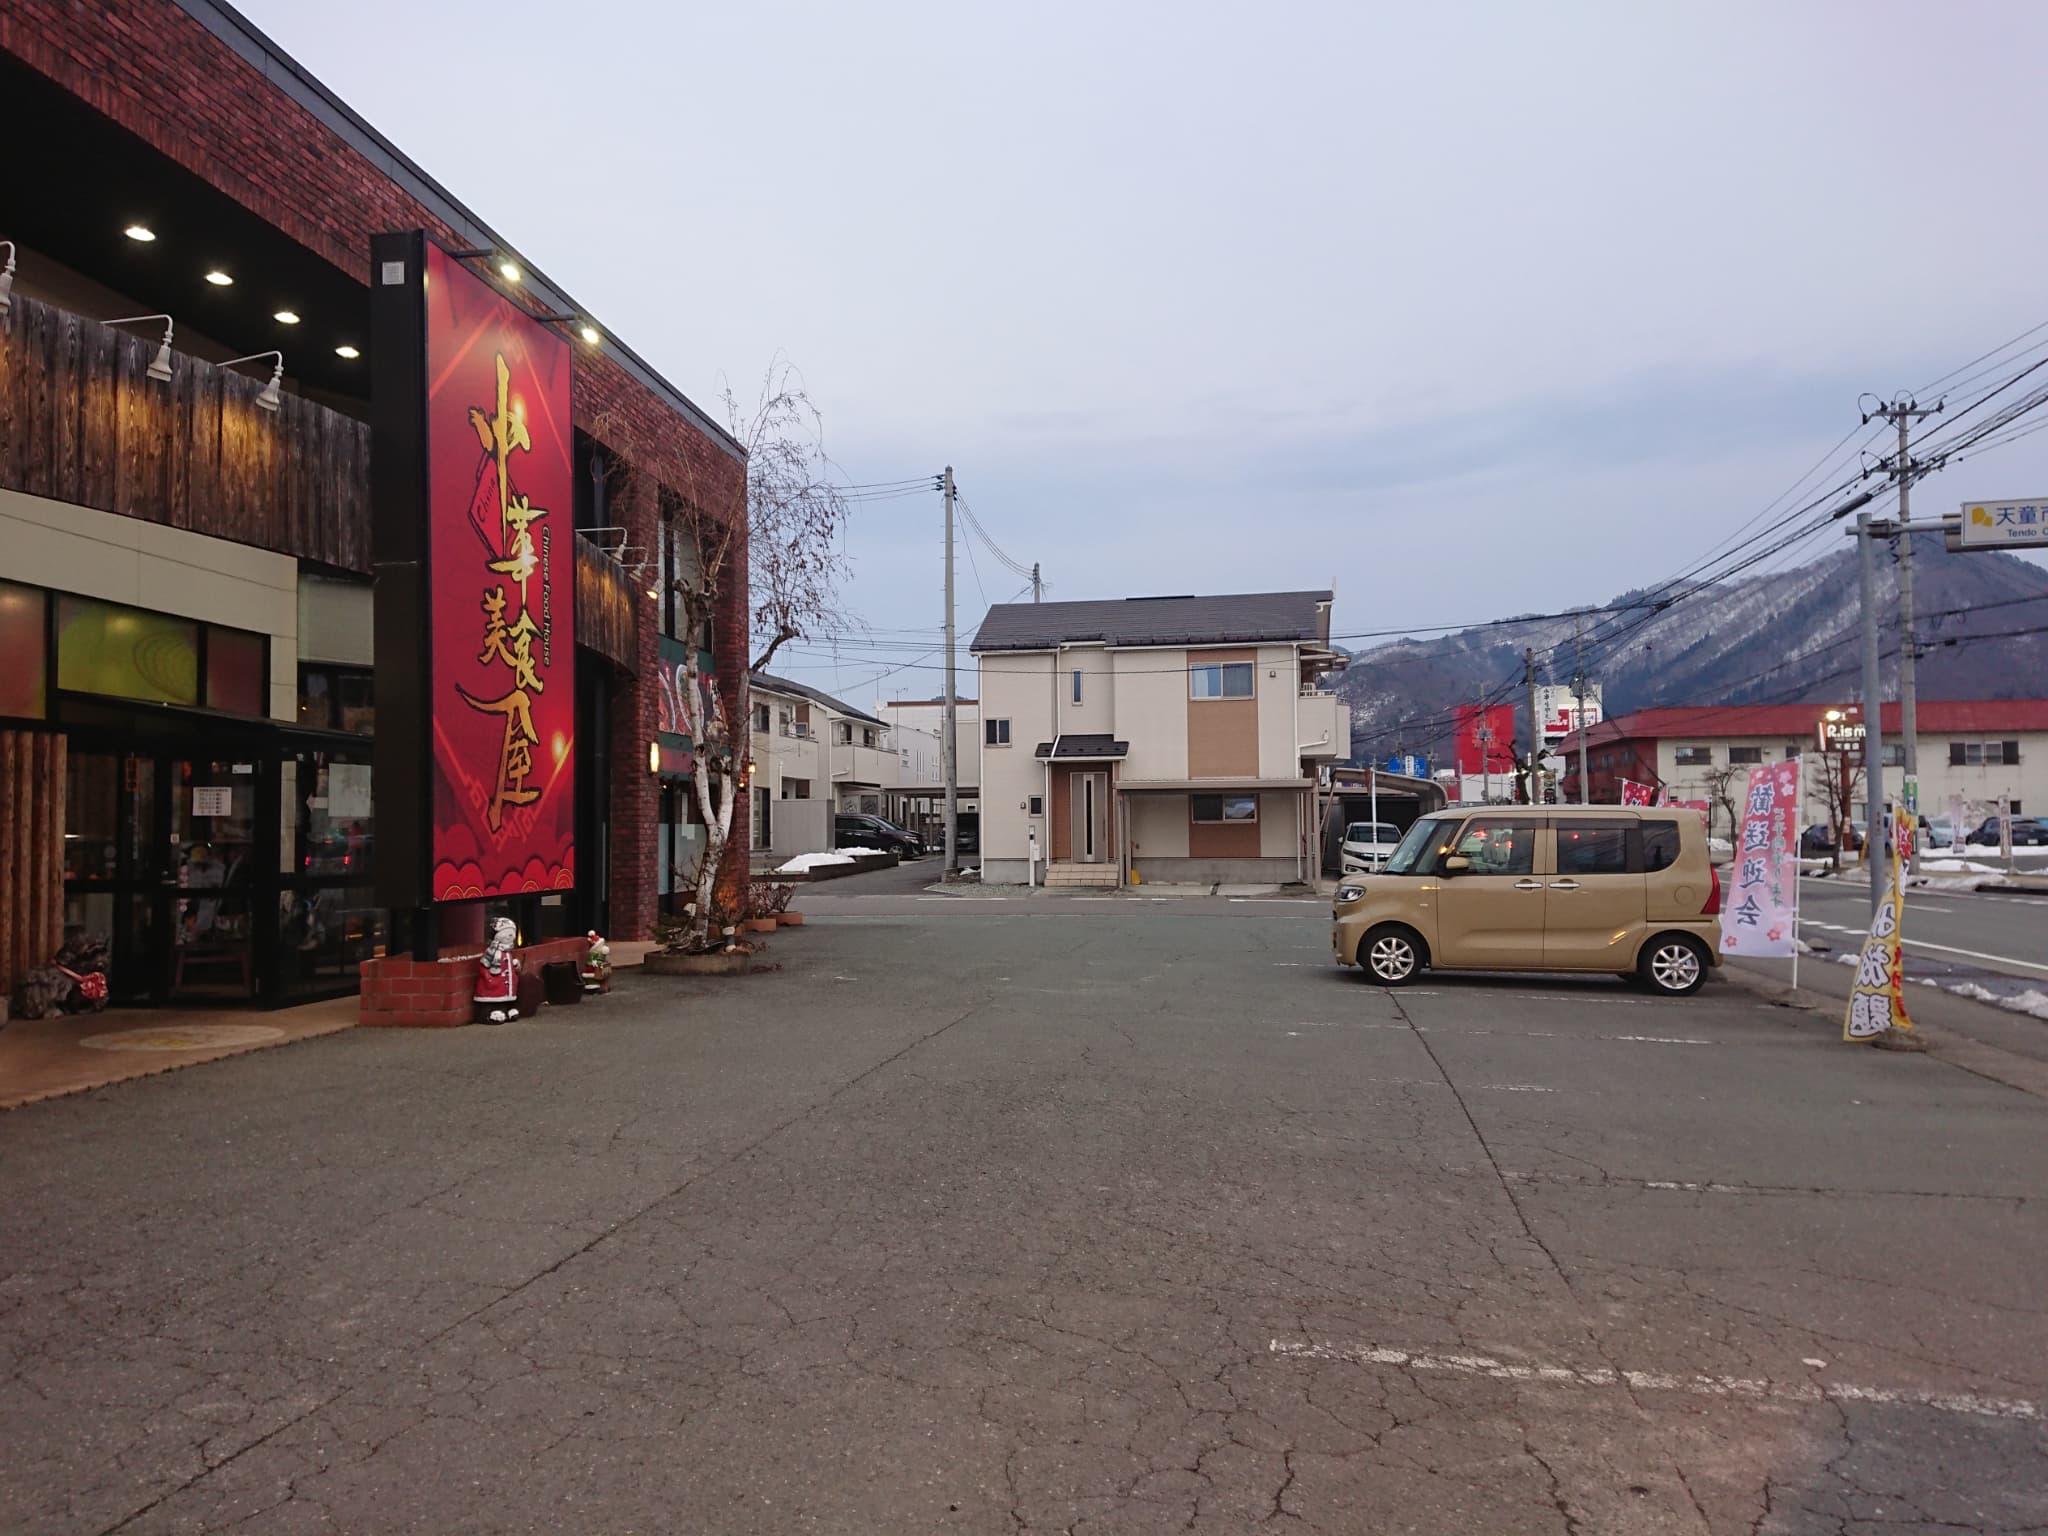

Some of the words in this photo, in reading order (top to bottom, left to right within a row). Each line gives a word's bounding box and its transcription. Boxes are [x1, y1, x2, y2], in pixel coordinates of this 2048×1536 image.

[477, 478, 496, 522] China
[543, 526, 551, 581] Chinese
[2007, 528, 2037, 538] Tendo
[543, 584, 551, 618] Food
[543, 622, 551, 666] House
